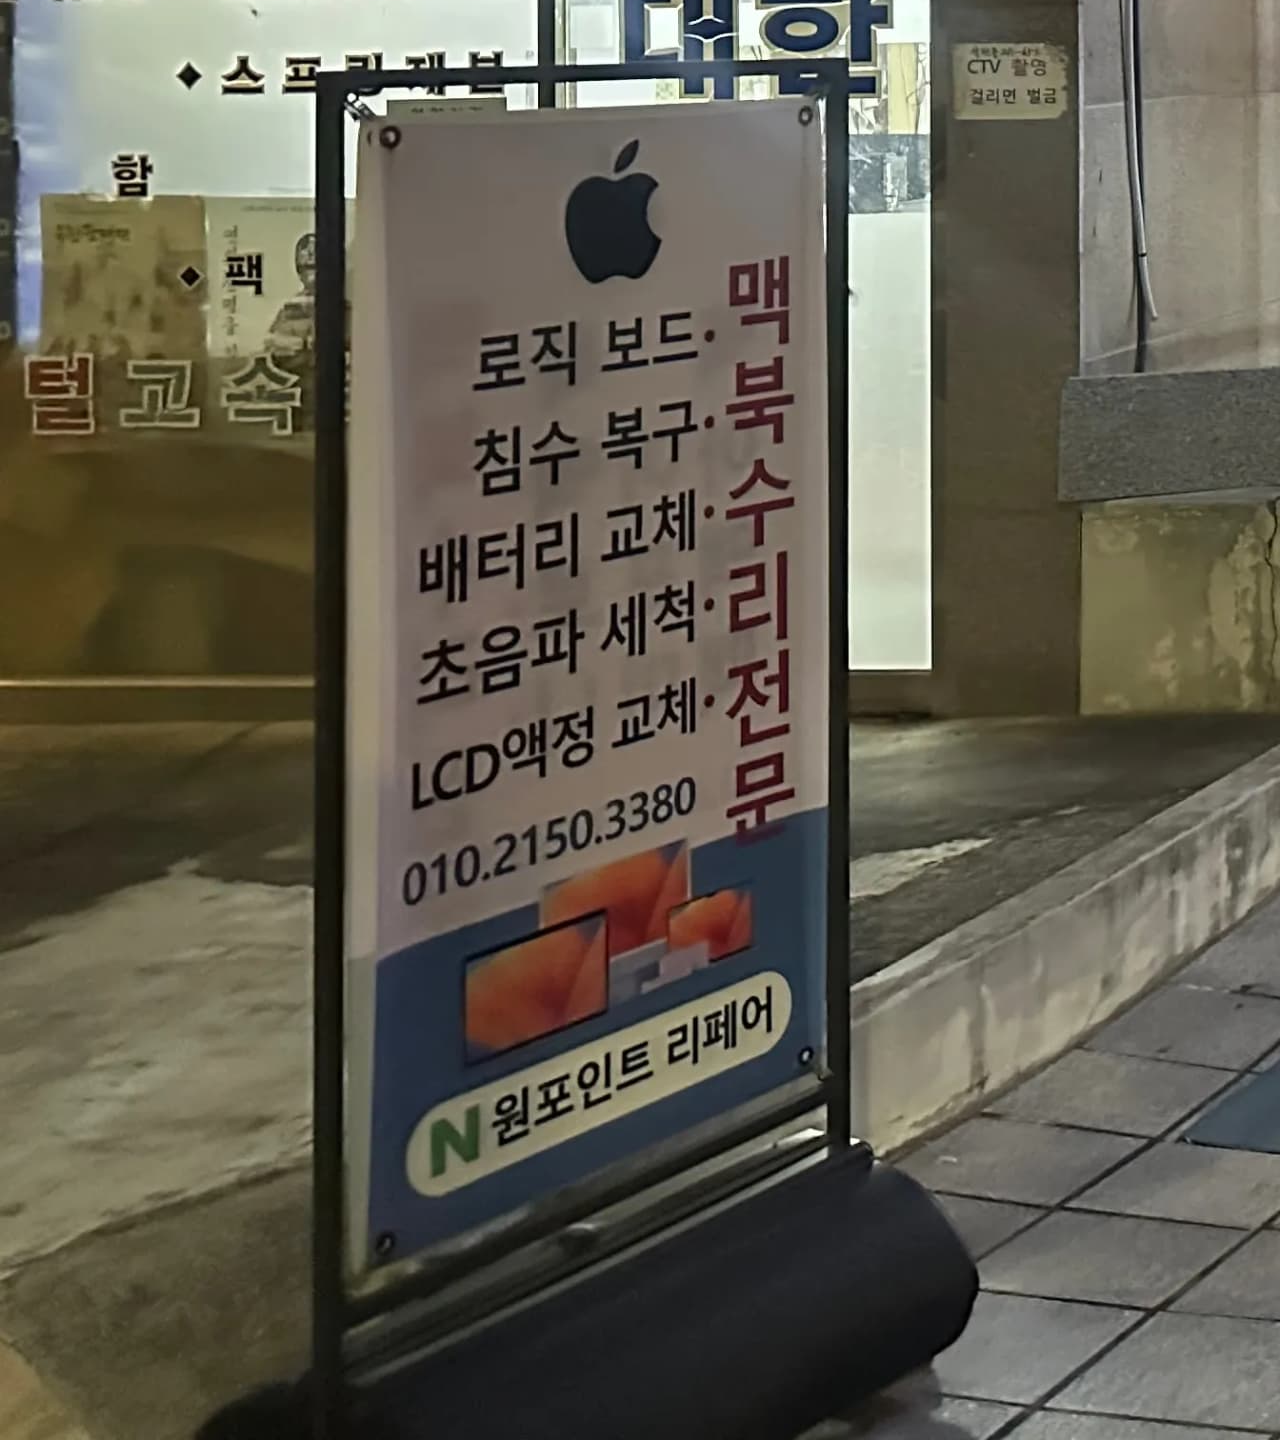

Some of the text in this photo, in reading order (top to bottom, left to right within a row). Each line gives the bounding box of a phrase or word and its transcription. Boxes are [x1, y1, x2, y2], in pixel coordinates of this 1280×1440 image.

[970, 88, 1056, 105] 걸리면 벌금
[472, 311, 699, 392] 로직 보드
[473, 400, 699, 497] 침수 복구
[418, 489, 696, 604] 배터리 교체
[725, 255, 796, 846] 맥북수리전문
[416, 580, 696, 705] 초음파 세척
[411, 677, 697, 811] LCD액정 교체
[402, 777, 697, 906] 010.2150.3380
[491, 1041, 655, 1146] 원포인트
[667, 986, 773, 1065] 리페어
